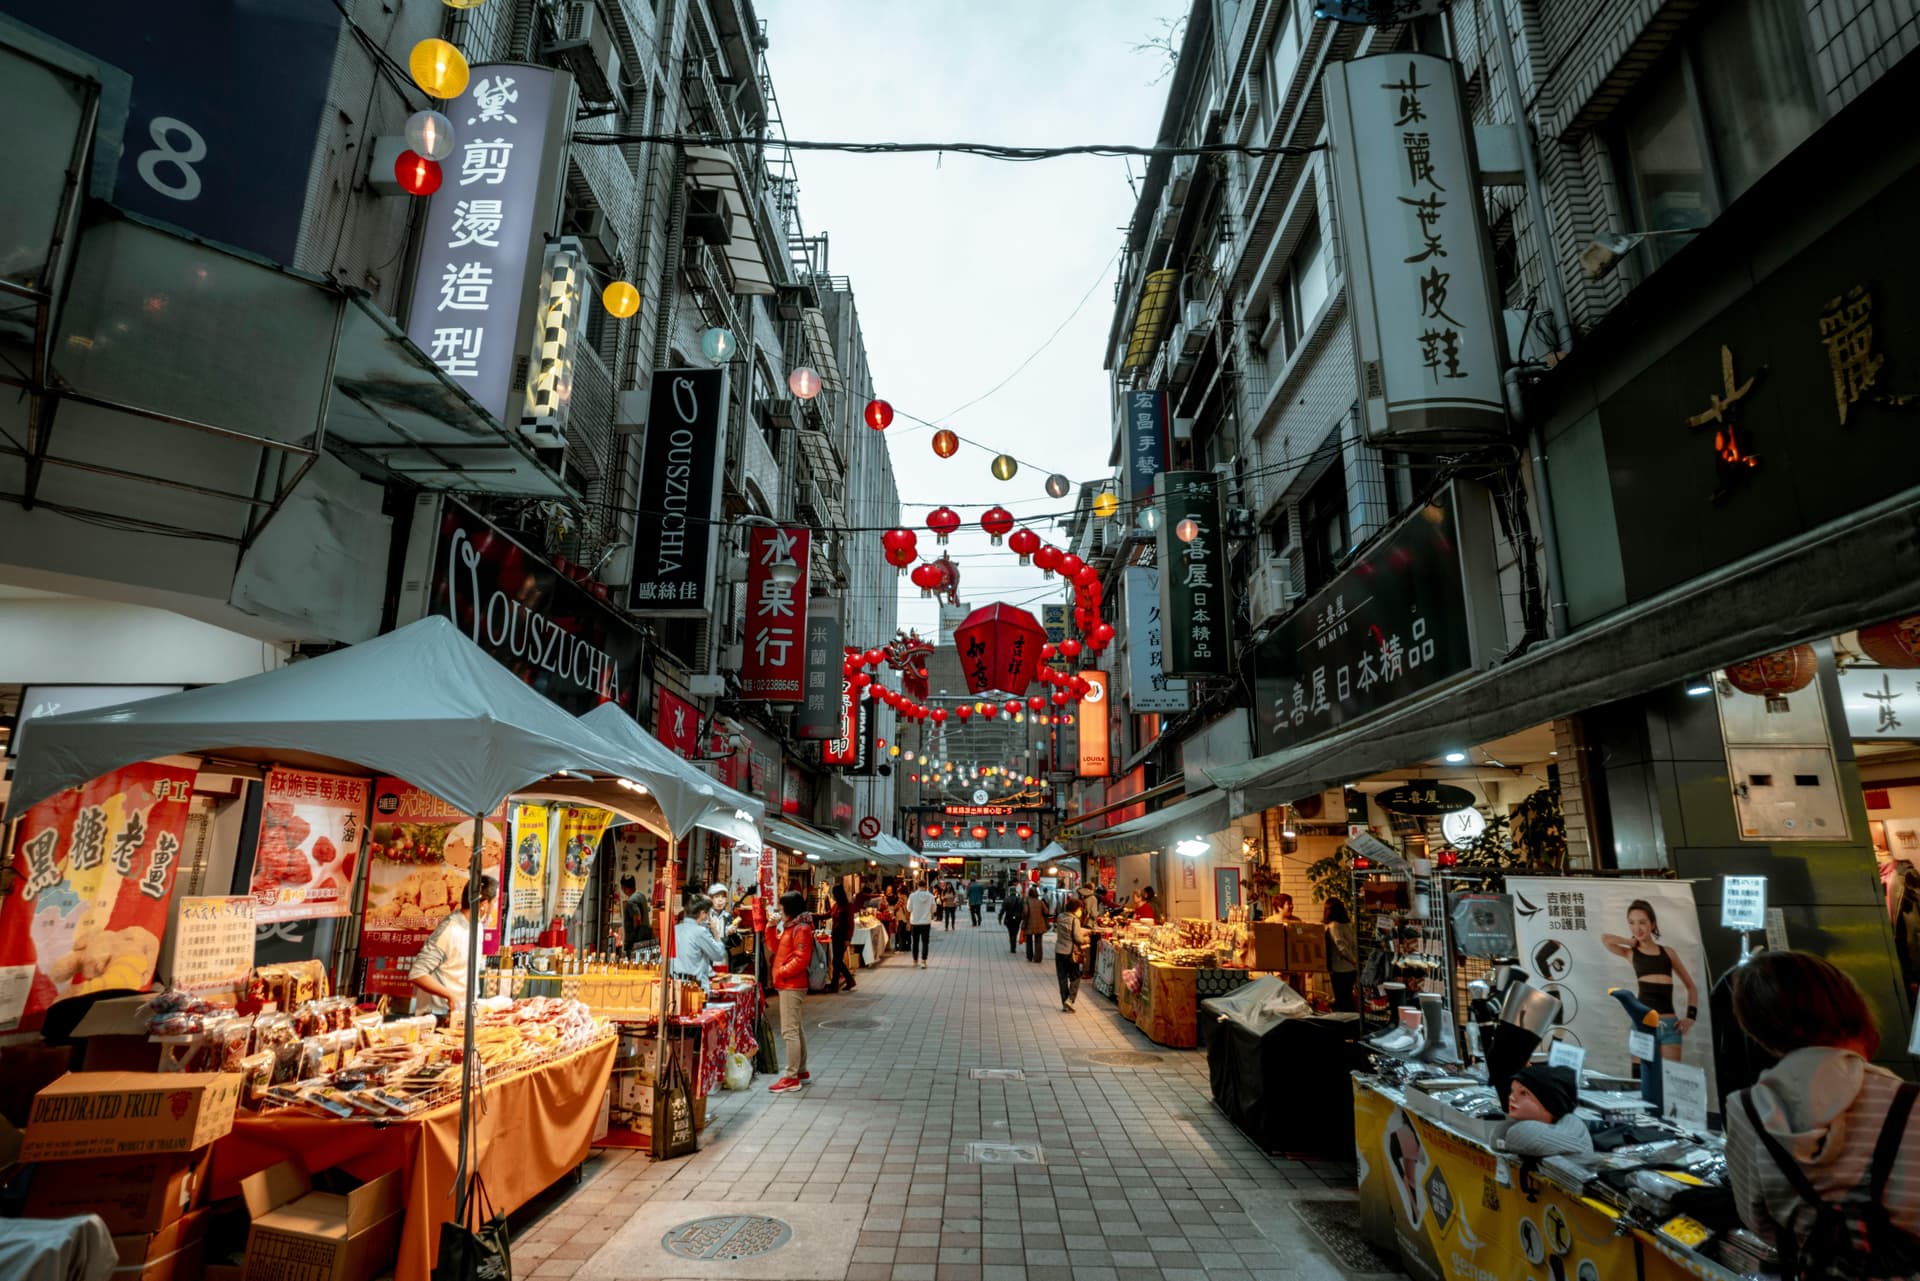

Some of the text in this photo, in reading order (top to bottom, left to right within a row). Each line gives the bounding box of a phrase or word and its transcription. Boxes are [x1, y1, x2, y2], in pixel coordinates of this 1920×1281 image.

[137, 116, 207, 200] 8
[1083, 755, 1105, 763] LOUISA
[152, 778, 190, 802] 手工
[341, 812, 356, 843] 大湖
[32, 1092, 164, 1123] DEHYDRATED FRUIT
